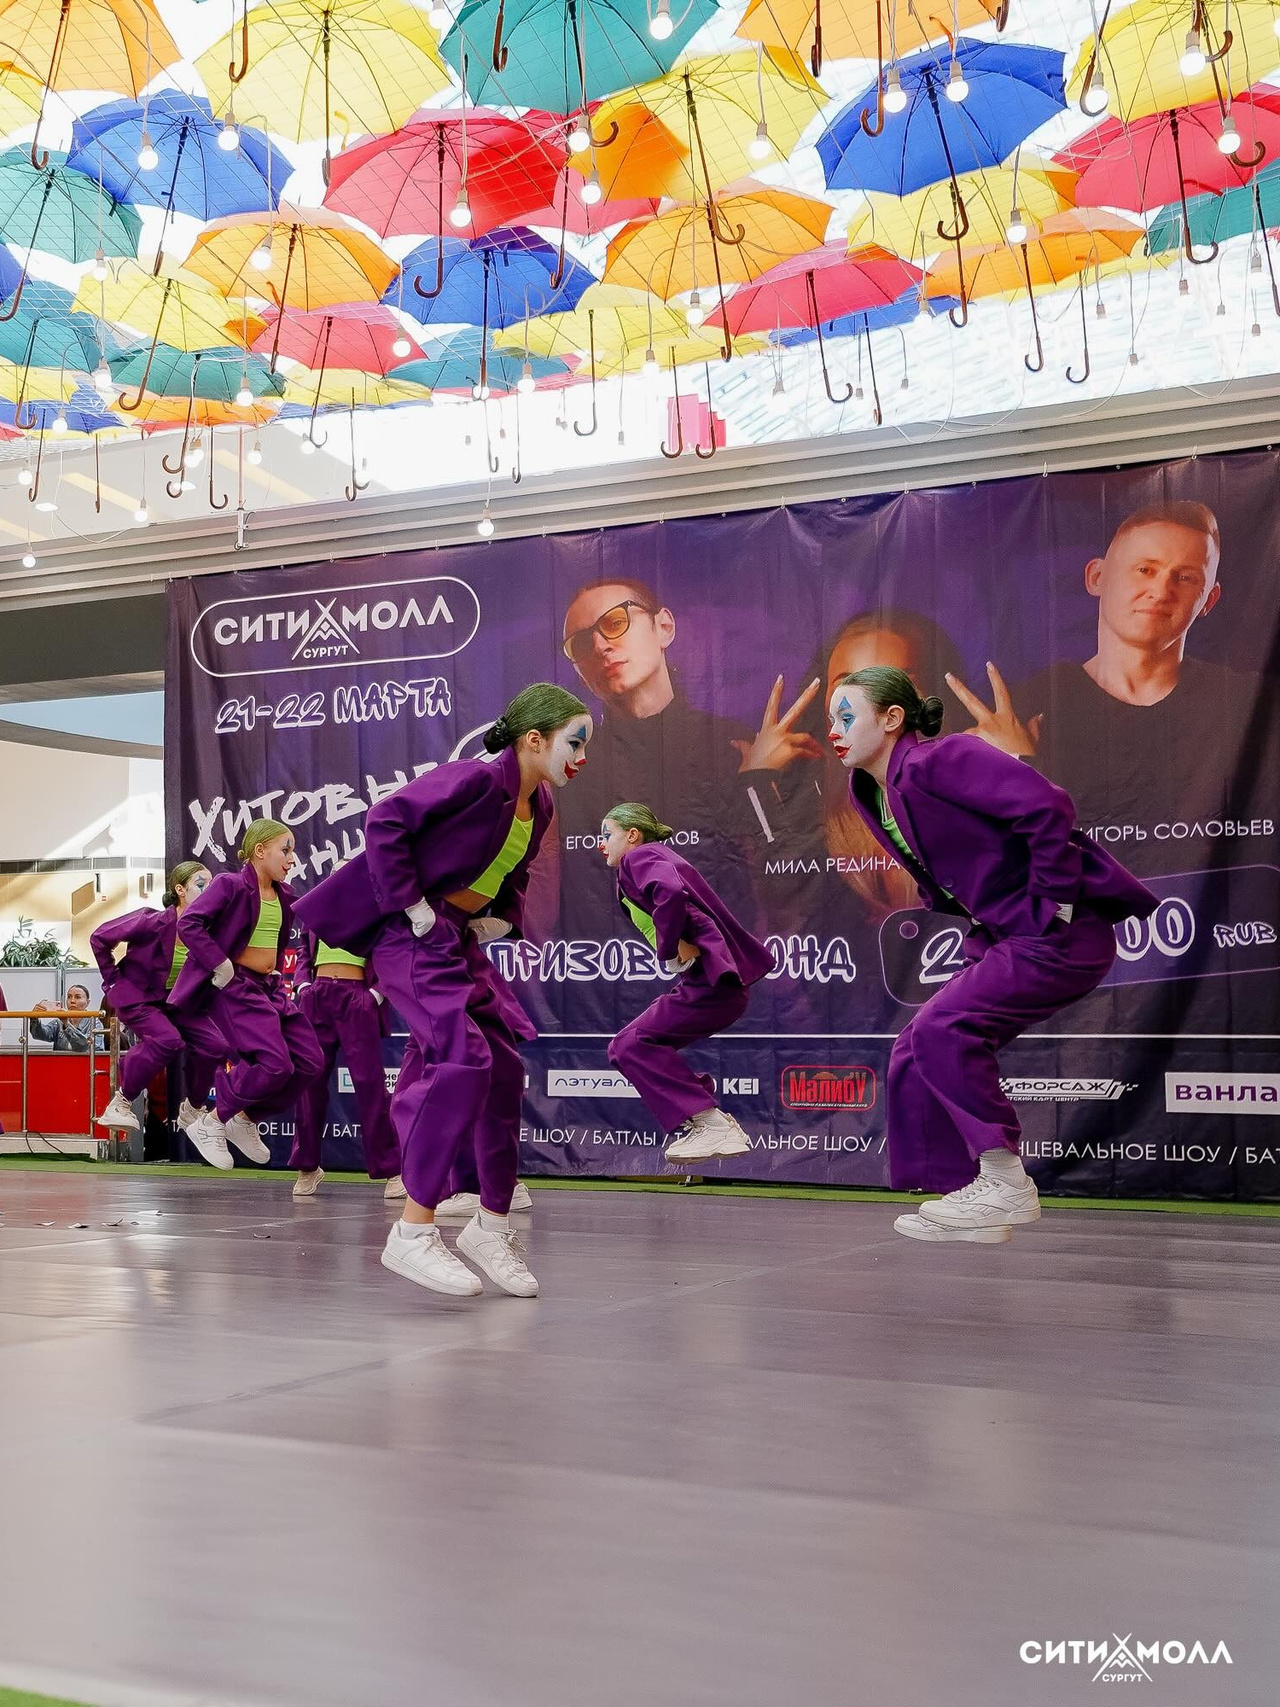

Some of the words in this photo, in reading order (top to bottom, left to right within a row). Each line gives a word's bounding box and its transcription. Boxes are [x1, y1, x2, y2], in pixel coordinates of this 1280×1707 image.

[302, 645, 349, 659] СУРГУТ
[214, 691, 326, 734] 21-22
[333, 677, 452, 724] МАРТА
[1153, 818, 1275, 840] СОЛОВЬЕВ
[765, 858, 821, 875] МИЛА
[826, 855, 901, 873] РЕДИНА
[1213, 921, 1278, 949] RUB
[763, 934, 856, 983] ОНД
[1015, 1081, 1106, 1092] ФОРСАЖ
[533, 1129, 576, 1144] ШОУ
[593, 1130, 656, 1146] БАТТЛЫ
[824, 1136, 873, 1152] ШОУ
[1163, 1144, 1221, 1163] ШОУ
